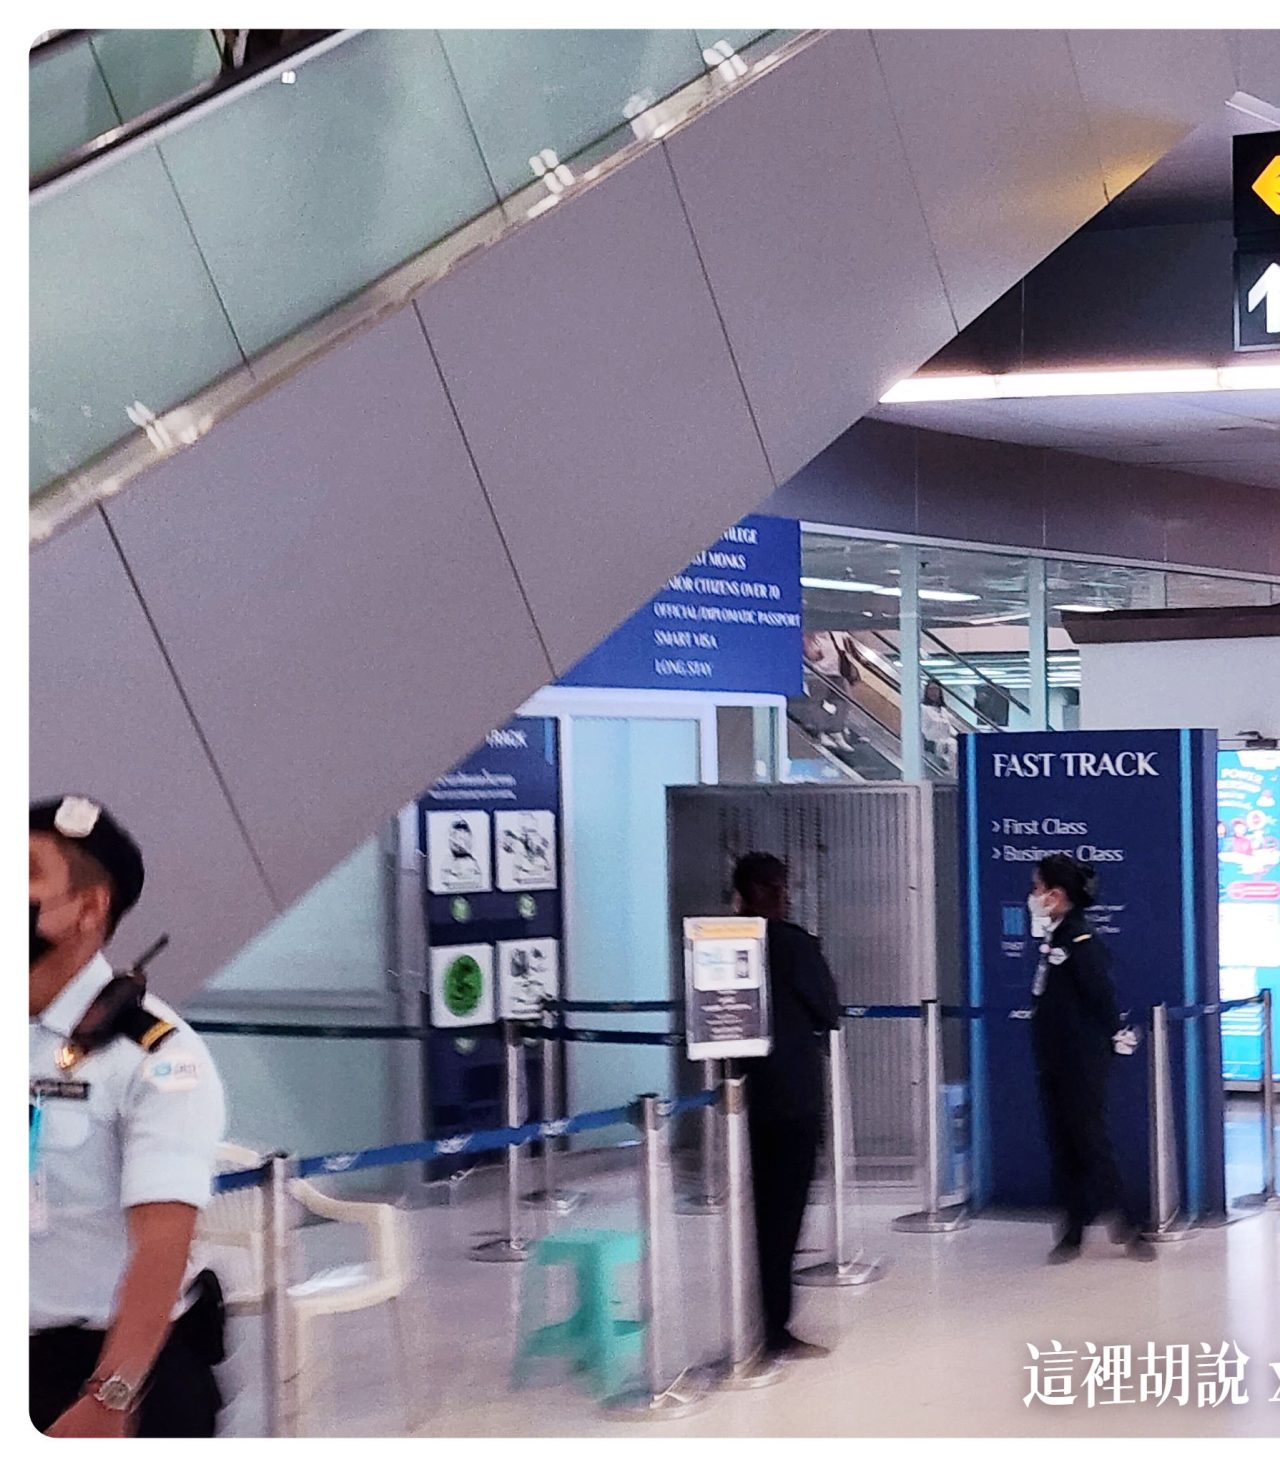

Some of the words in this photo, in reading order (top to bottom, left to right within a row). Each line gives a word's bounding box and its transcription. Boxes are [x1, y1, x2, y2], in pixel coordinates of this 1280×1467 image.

[709, 551, 747, 571] MONKS
[694, 579, 740, 598] CITIZENS
[740, 583, 768, 599] OVER
[653, 629, 692, 647] SMART
[692, 632, 718, 649] VISA
[654, 658, 686, 676] LONG
[992, 752, 1056, 777] FAST
[1060, 751, 1160, 776] TRACK
[1002, 818, 1040, 834] First
[1041, 818, 1088, 834] Class
[1076, 845, 1124, 861] Class
